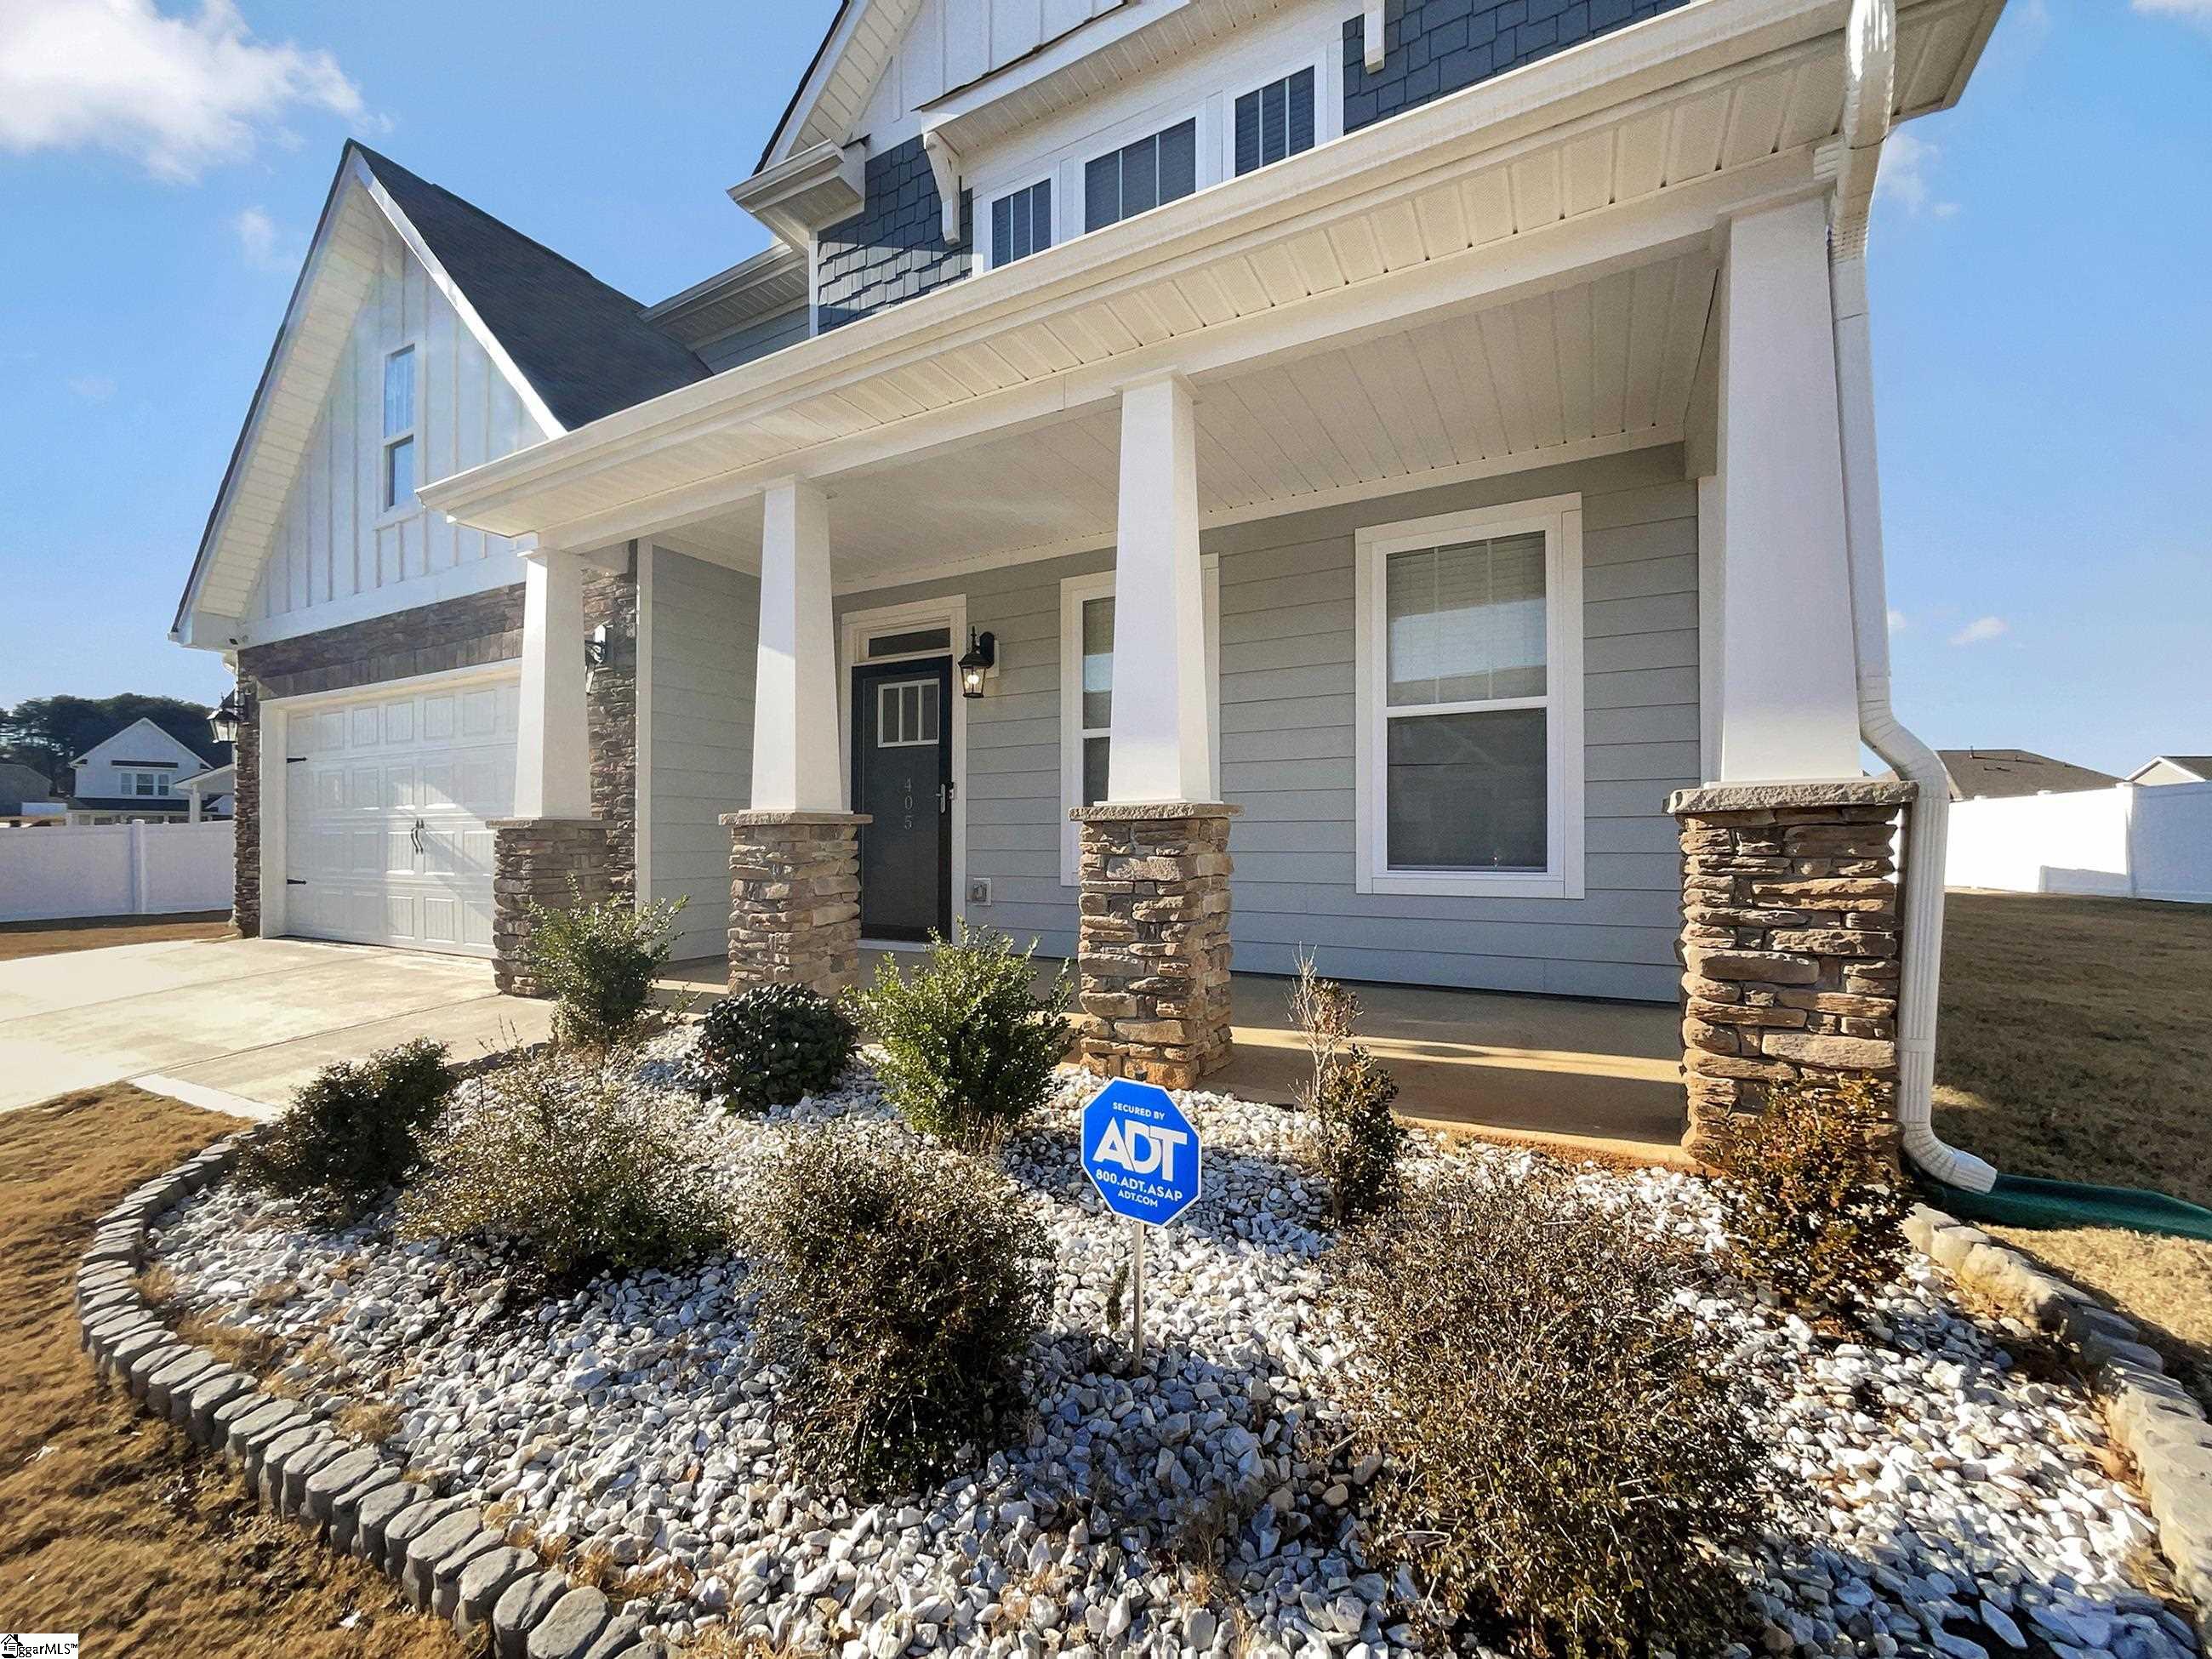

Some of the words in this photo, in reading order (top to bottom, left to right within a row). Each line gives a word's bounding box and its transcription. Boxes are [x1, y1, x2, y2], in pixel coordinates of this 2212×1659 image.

[1113, 1102, 1151, 1117] SECURED
[1154, 1111, 1166, 1120] BY
[1092, 1116, 1188, 1182] ADT
[1096, 1169, 1183, 1201] 800.ADT.ASAP
[1118, 1189, 1158, 1207] ADT.COM
